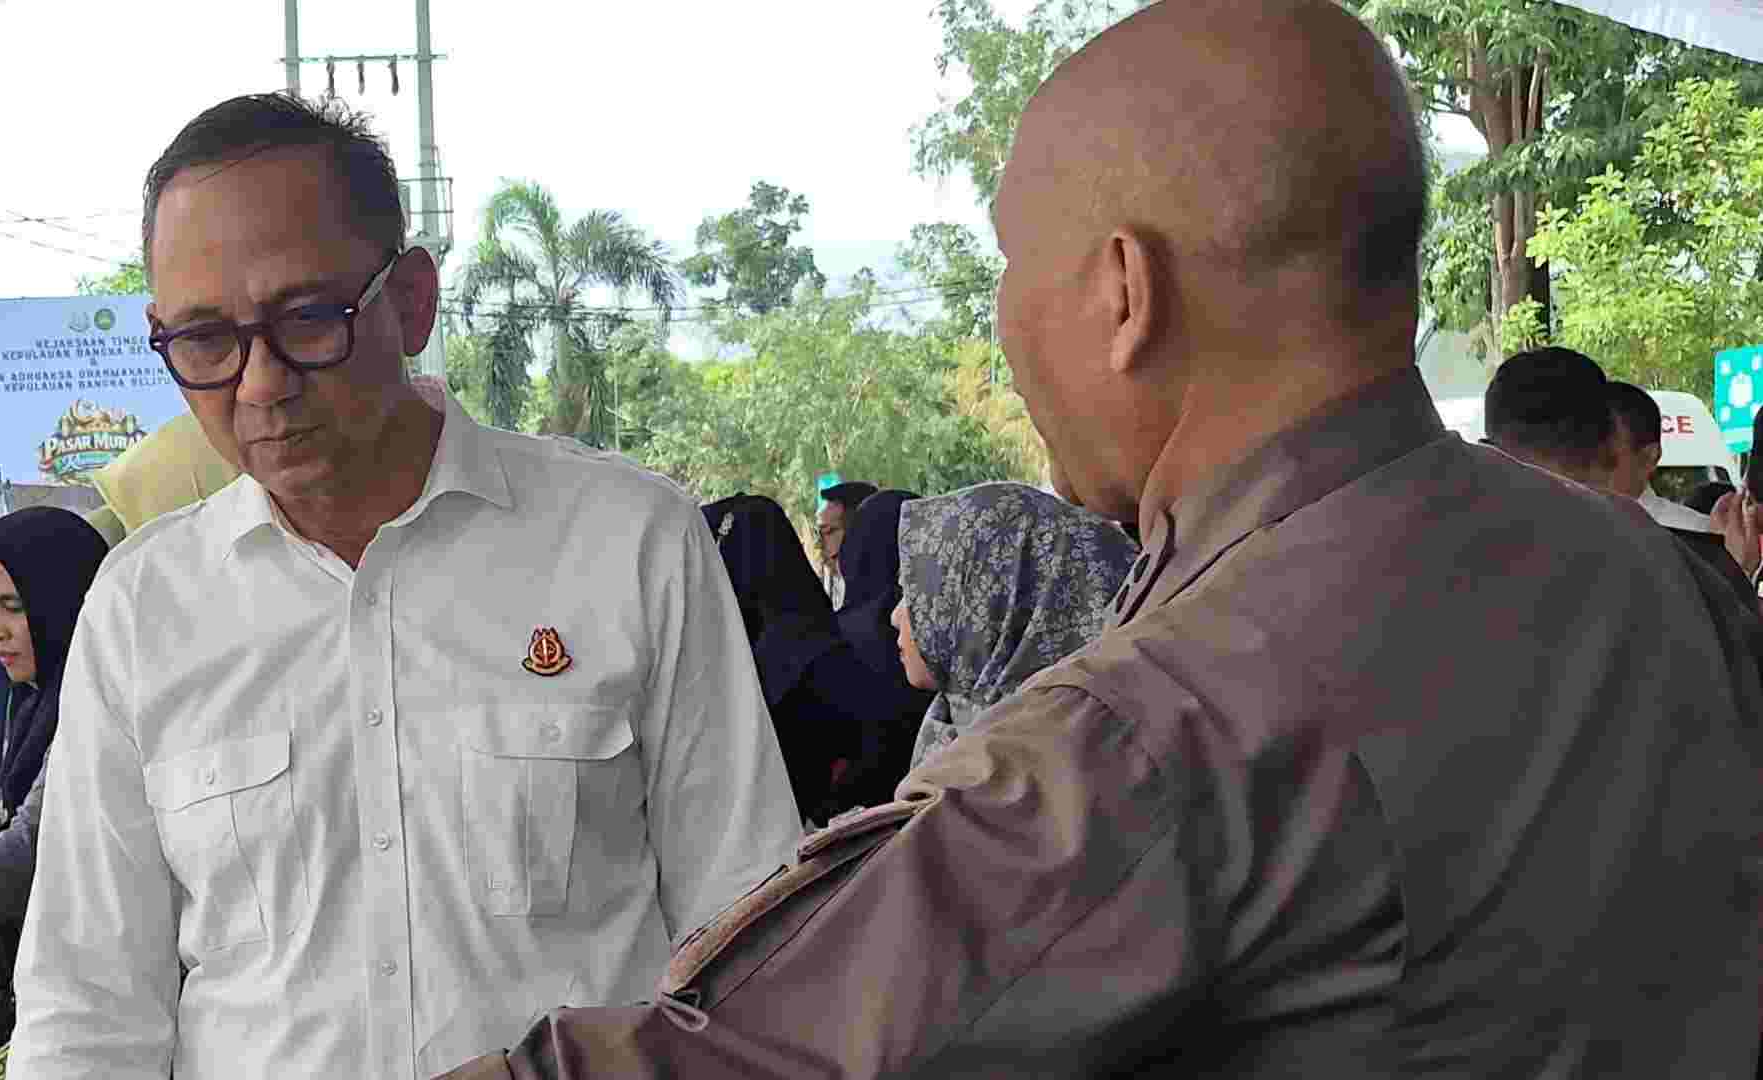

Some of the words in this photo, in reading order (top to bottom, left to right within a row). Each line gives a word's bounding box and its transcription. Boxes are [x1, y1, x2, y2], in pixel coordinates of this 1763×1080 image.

[35, 337, 106, 349] KEJAKSAAN
[112, 336, 147, 347] TINGG
[1, 349, 72, 361] KEPULAUAN
[77, 347, 123, 359] BANGKA
[4, 381, 73, 393] KEPULAUAN
[78, 379, 124, 390] BANGKA
[130, 376, 171, 388] BELITU
[44, 434, 95, 458] PASAR
